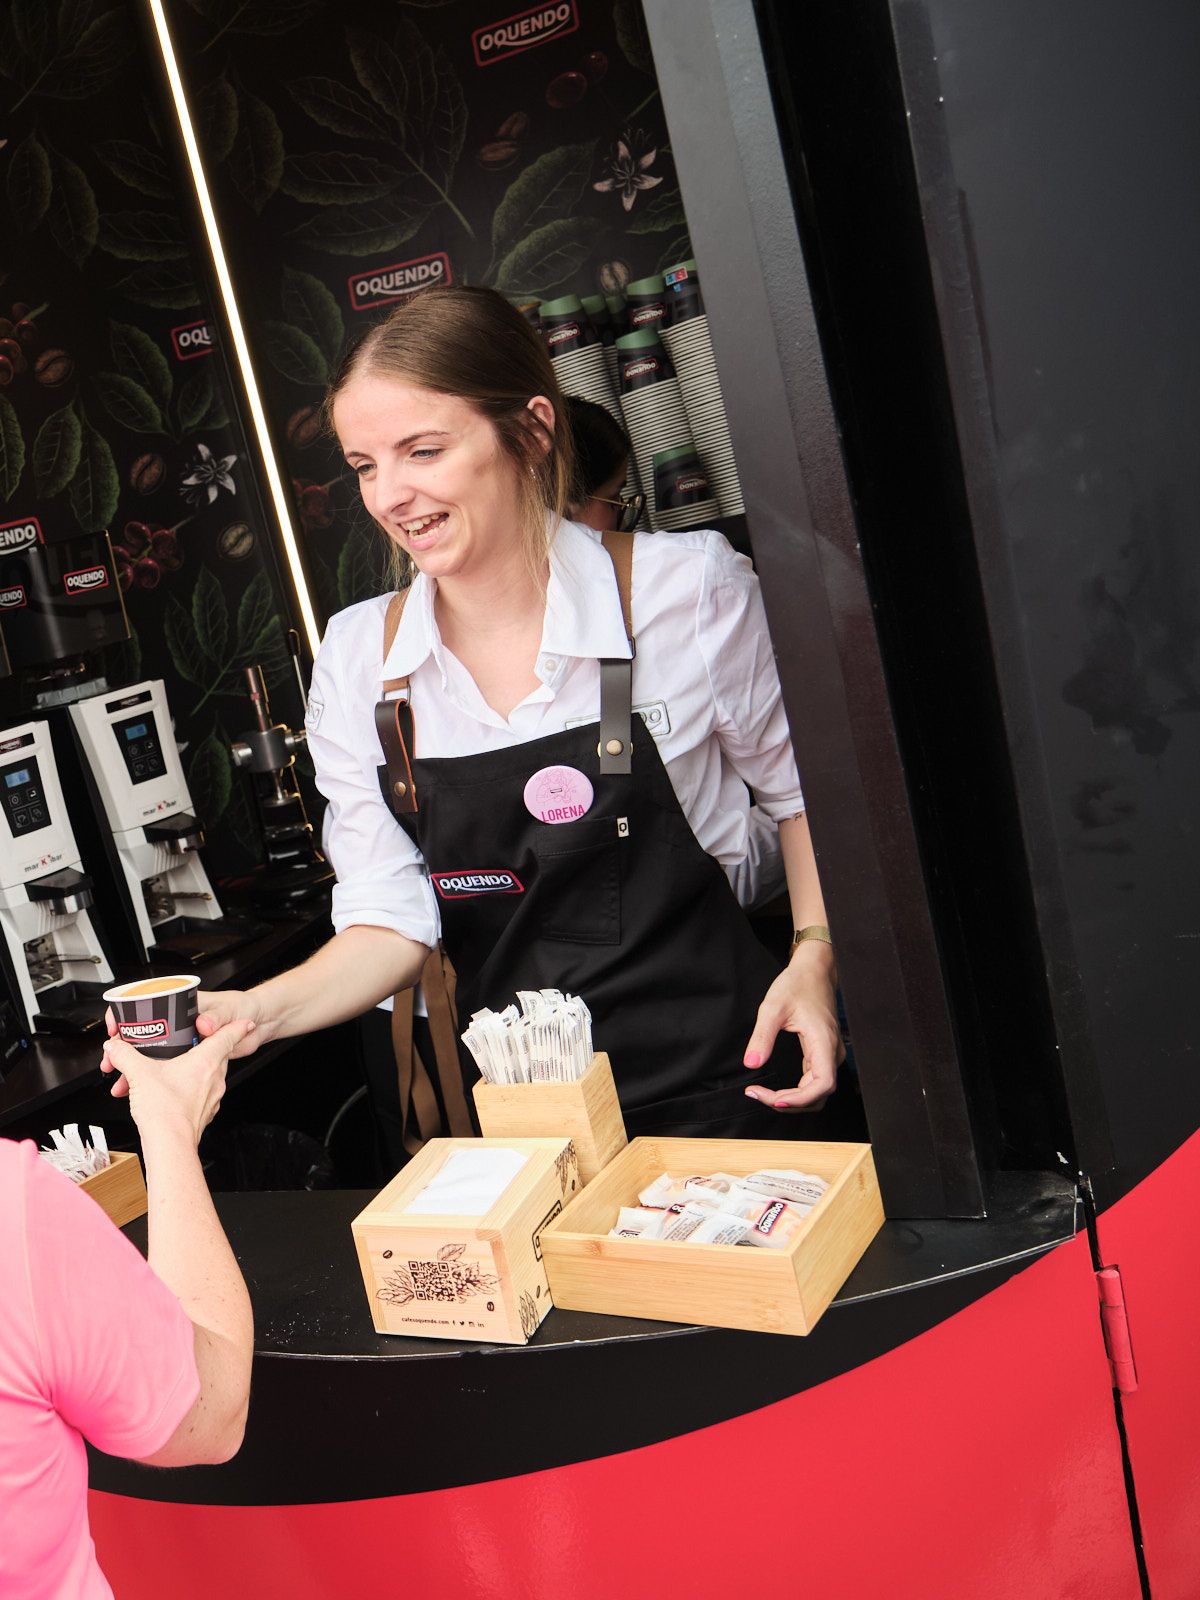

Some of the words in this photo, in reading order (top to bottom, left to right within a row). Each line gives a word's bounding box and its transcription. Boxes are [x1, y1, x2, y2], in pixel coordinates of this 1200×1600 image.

[480, 4, 570, 50] OQUENDO
[356, 261, 444, 296] OQUENDO
[67, 570, 104, 588] OQUENDO
[541, 804, 586, 823] LORENA
[619, 822, 627, 833] Q
[440, 875, 513, 891] OQUENDO
[120, 1023, 165, 1039] OQUENDO
[760, 1202, 784, 1233] OQUENDO
